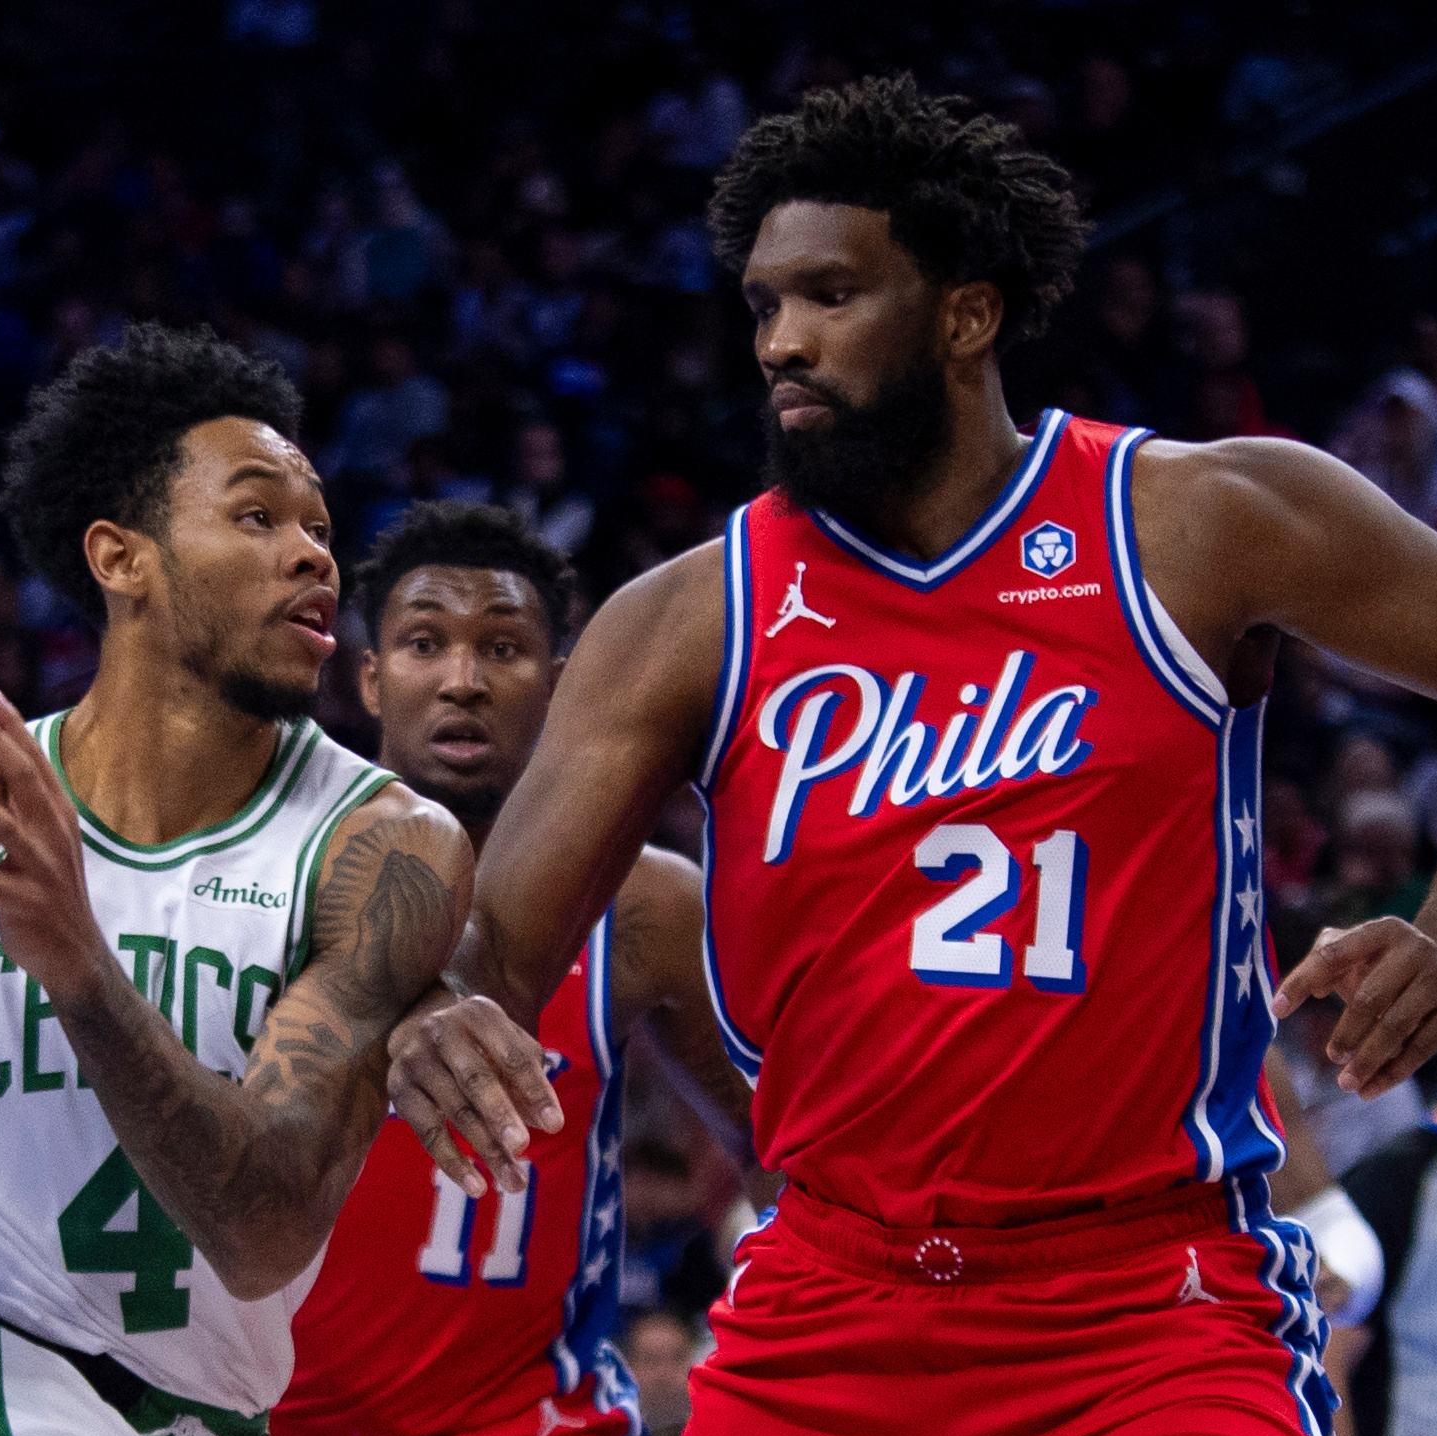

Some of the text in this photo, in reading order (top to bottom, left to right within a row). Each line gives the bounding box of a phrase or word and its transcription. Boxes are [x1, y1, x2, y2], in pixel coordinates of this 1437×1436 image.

[997, 582, 1102, 605] crypto.com
[758, 649, 1100, 865] Phila
[193, 876, 287, 909] Amica
[910, 823, 1091, 995] 21
[57, 1142, 194, 1335] 4
[418, 1157, 538, 1290] 11
